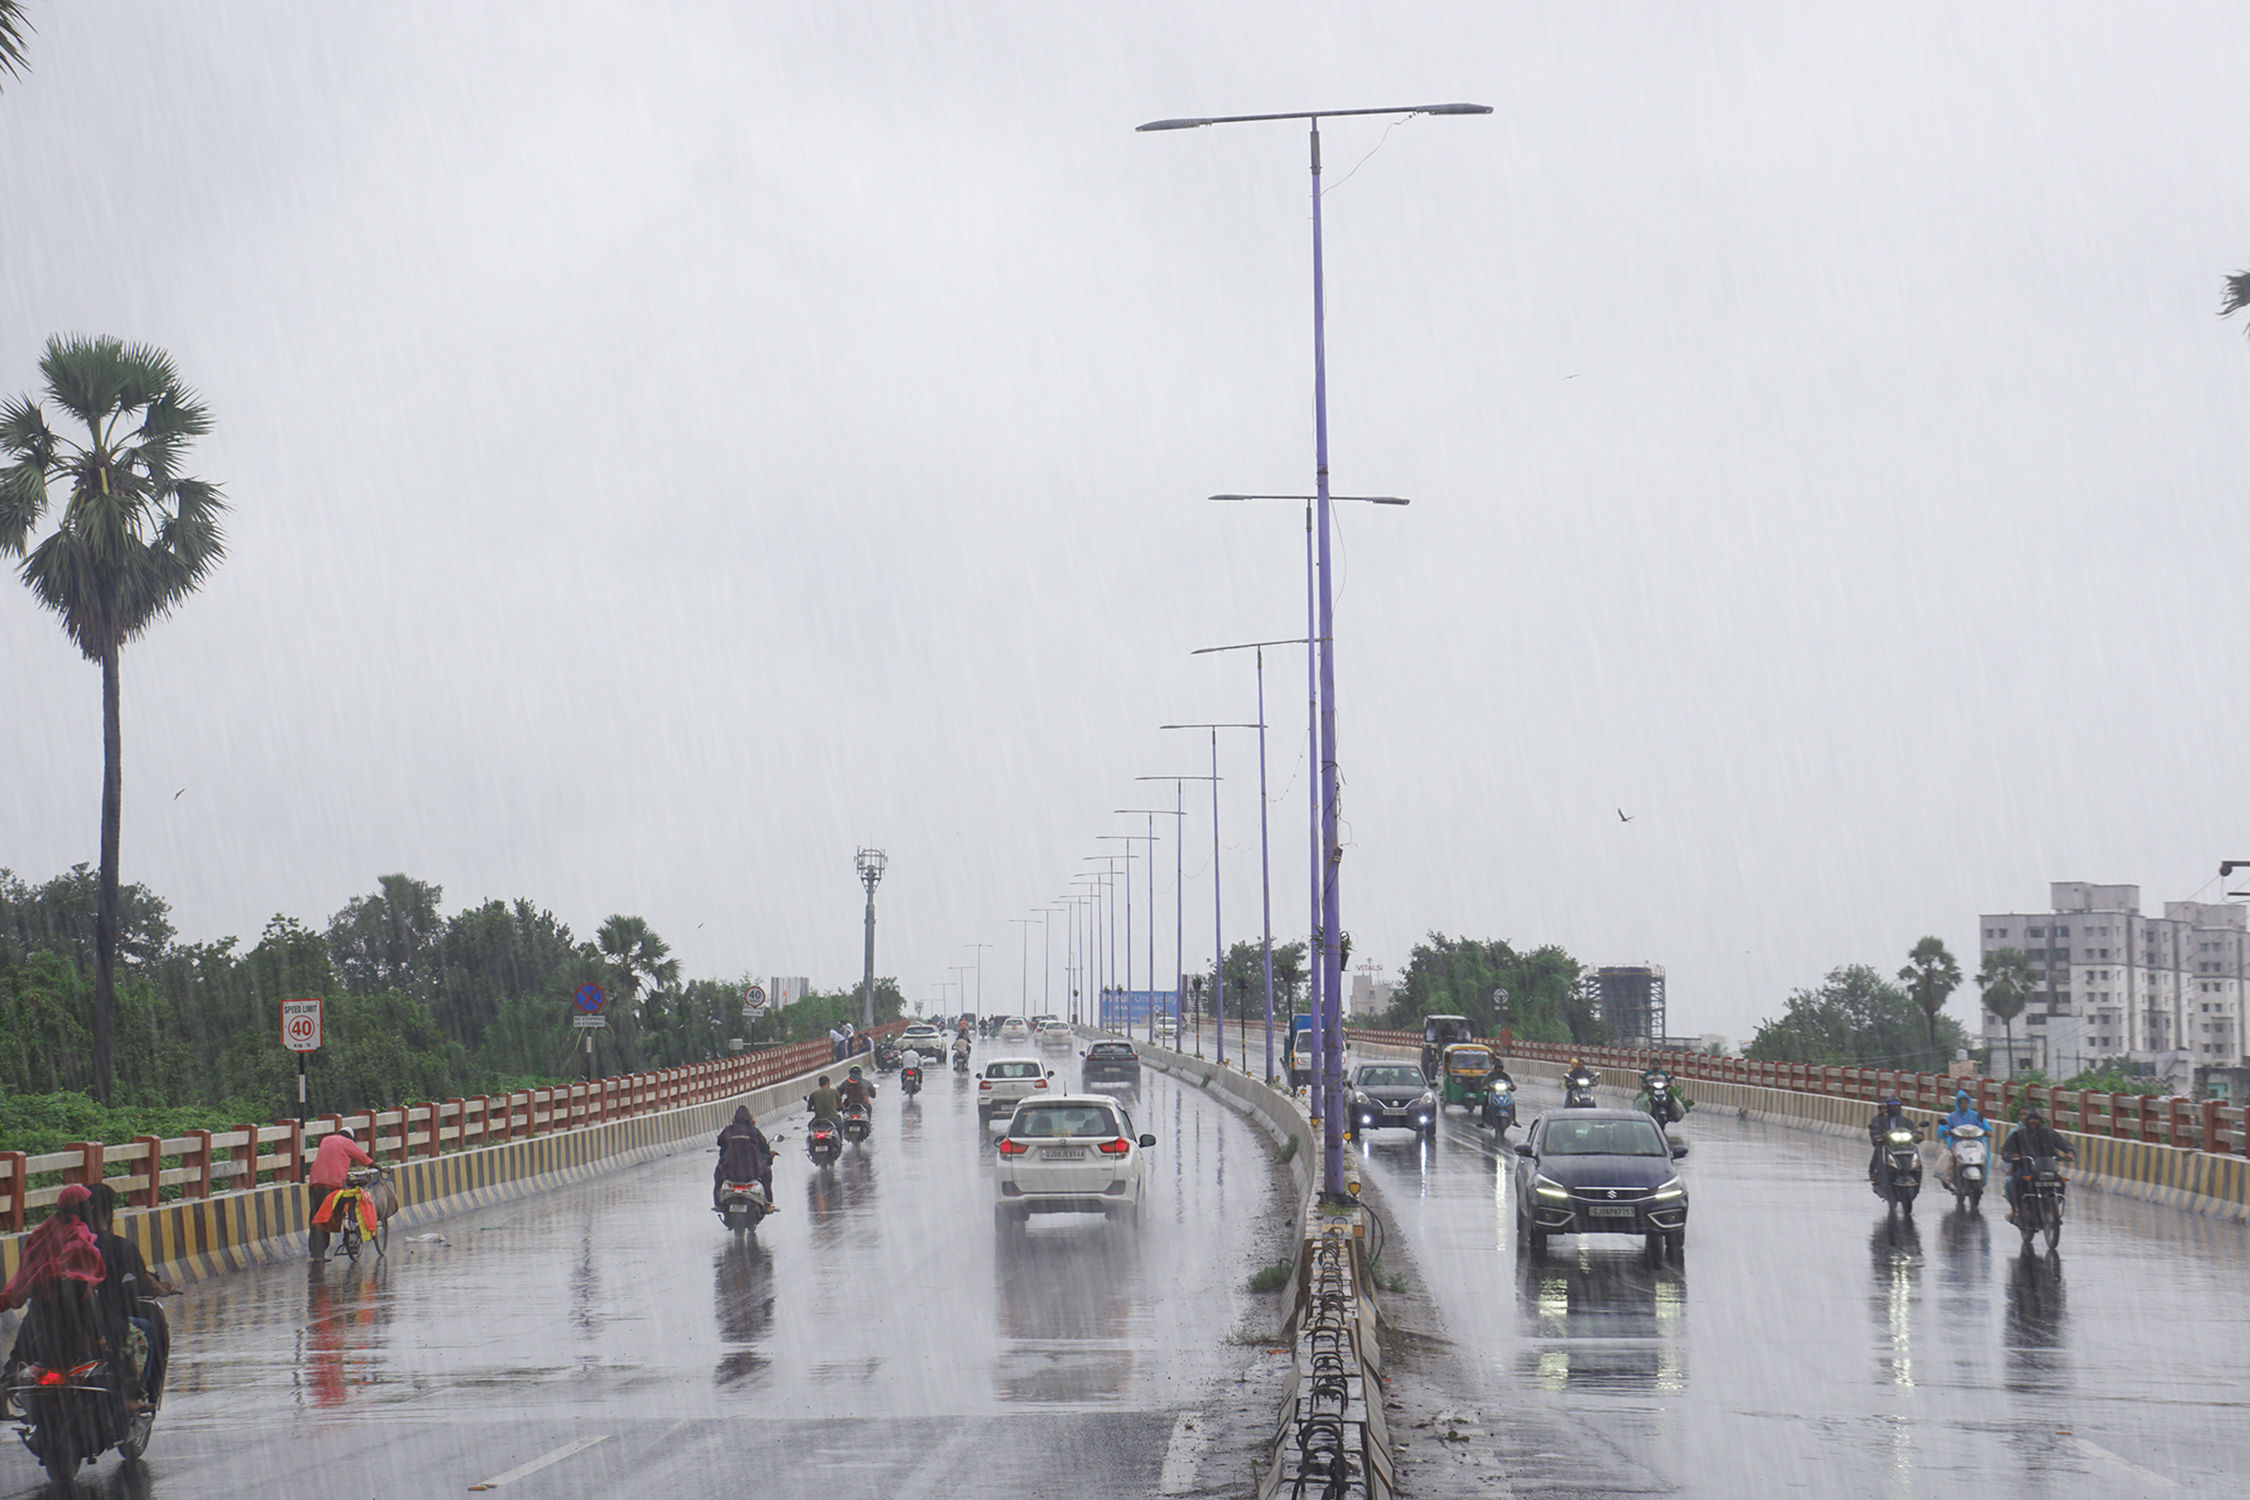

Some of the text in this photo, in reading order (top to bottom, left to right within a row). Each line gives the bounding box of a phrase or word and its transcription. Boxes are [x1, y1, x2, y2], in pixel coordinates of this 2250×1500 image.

[748, 990, 761, 999] 40
[1134, 994, 1177, 1006] Unierity
[284, 1004, 317, 1014] SPEED LIMIT
[291, 1020, 312, 1036] 40
